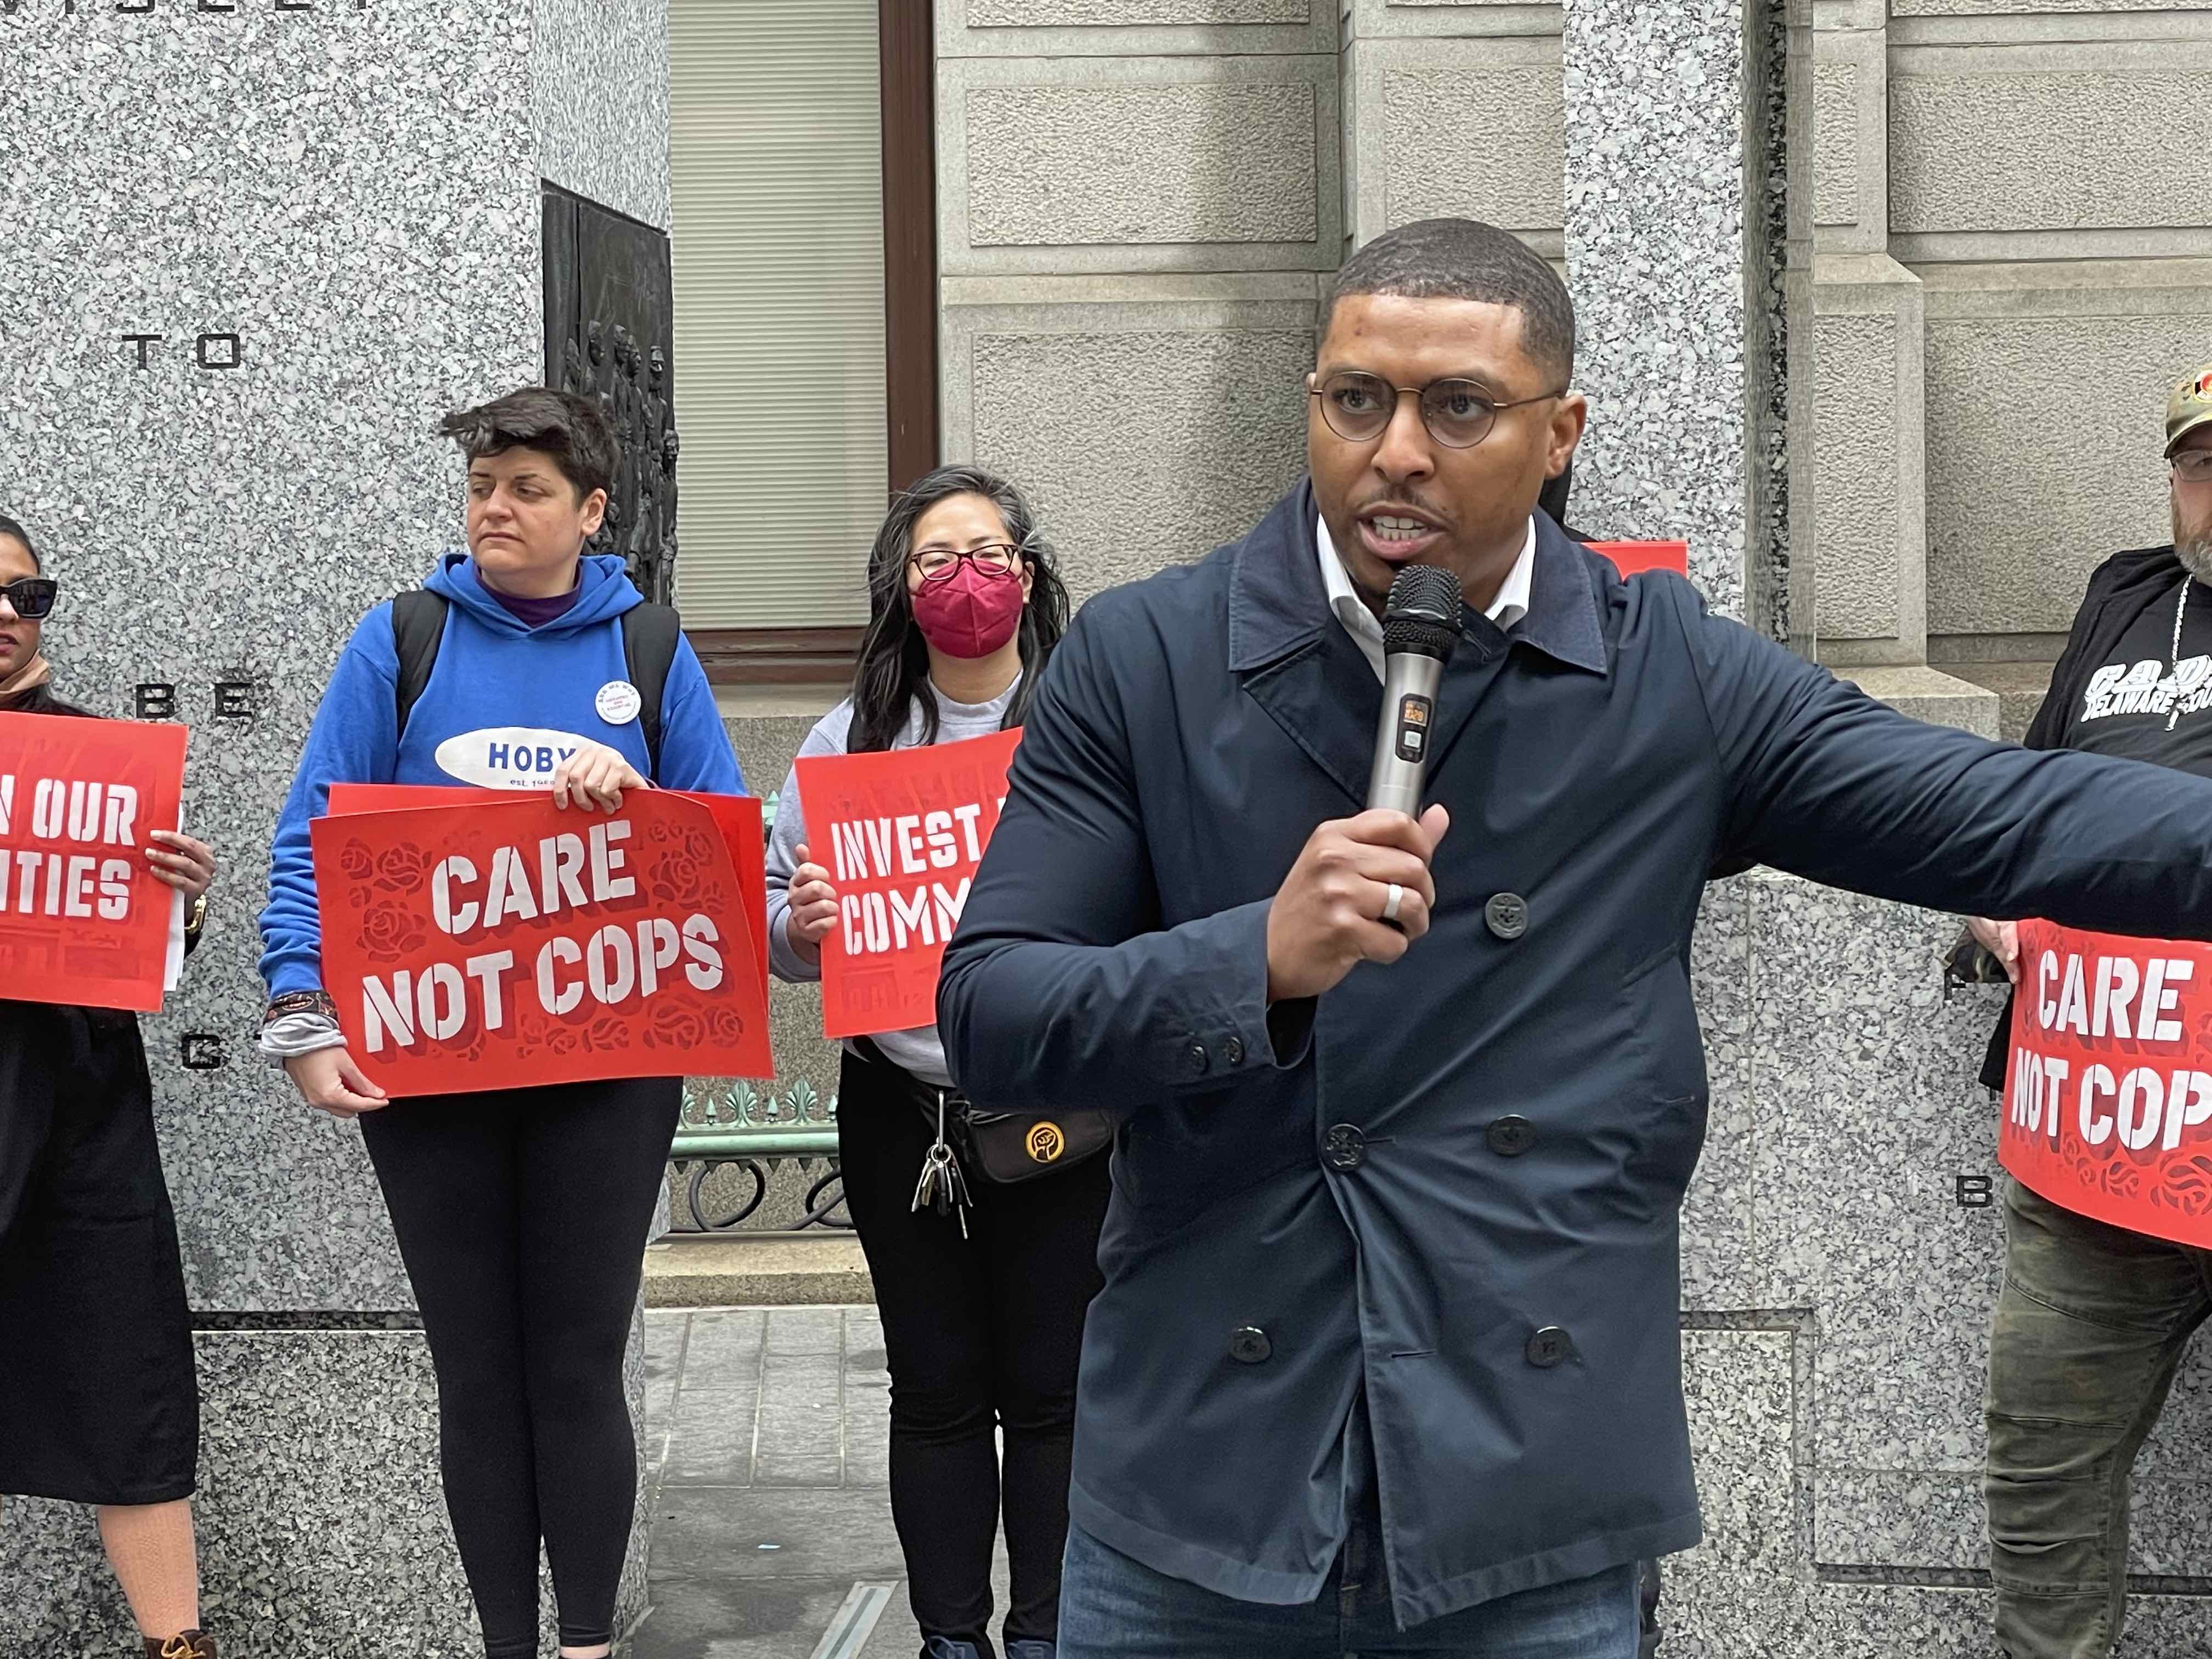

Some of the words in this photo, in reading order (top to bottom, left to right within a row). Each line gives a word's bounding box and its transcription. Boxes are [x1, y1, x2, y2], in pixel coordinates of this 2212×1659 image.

[122, 333, 240, 369] TO
[136, 684, 252, 719] BE
[489, 743, 577, 772] HOBY
[32, 778, 137, 847] OUR
[831, 803, 981, 881] INVEST
[432, 820, 635, 934] CARE
[363, 950, 514, 1053] NOT
[536, 913, 723, 1014] COPS
[2039, 950, 2194, 1041] CARE
[2011, 1047, 2069, 1137] NOT
[2079, 1063, 2212, 1151] COP
